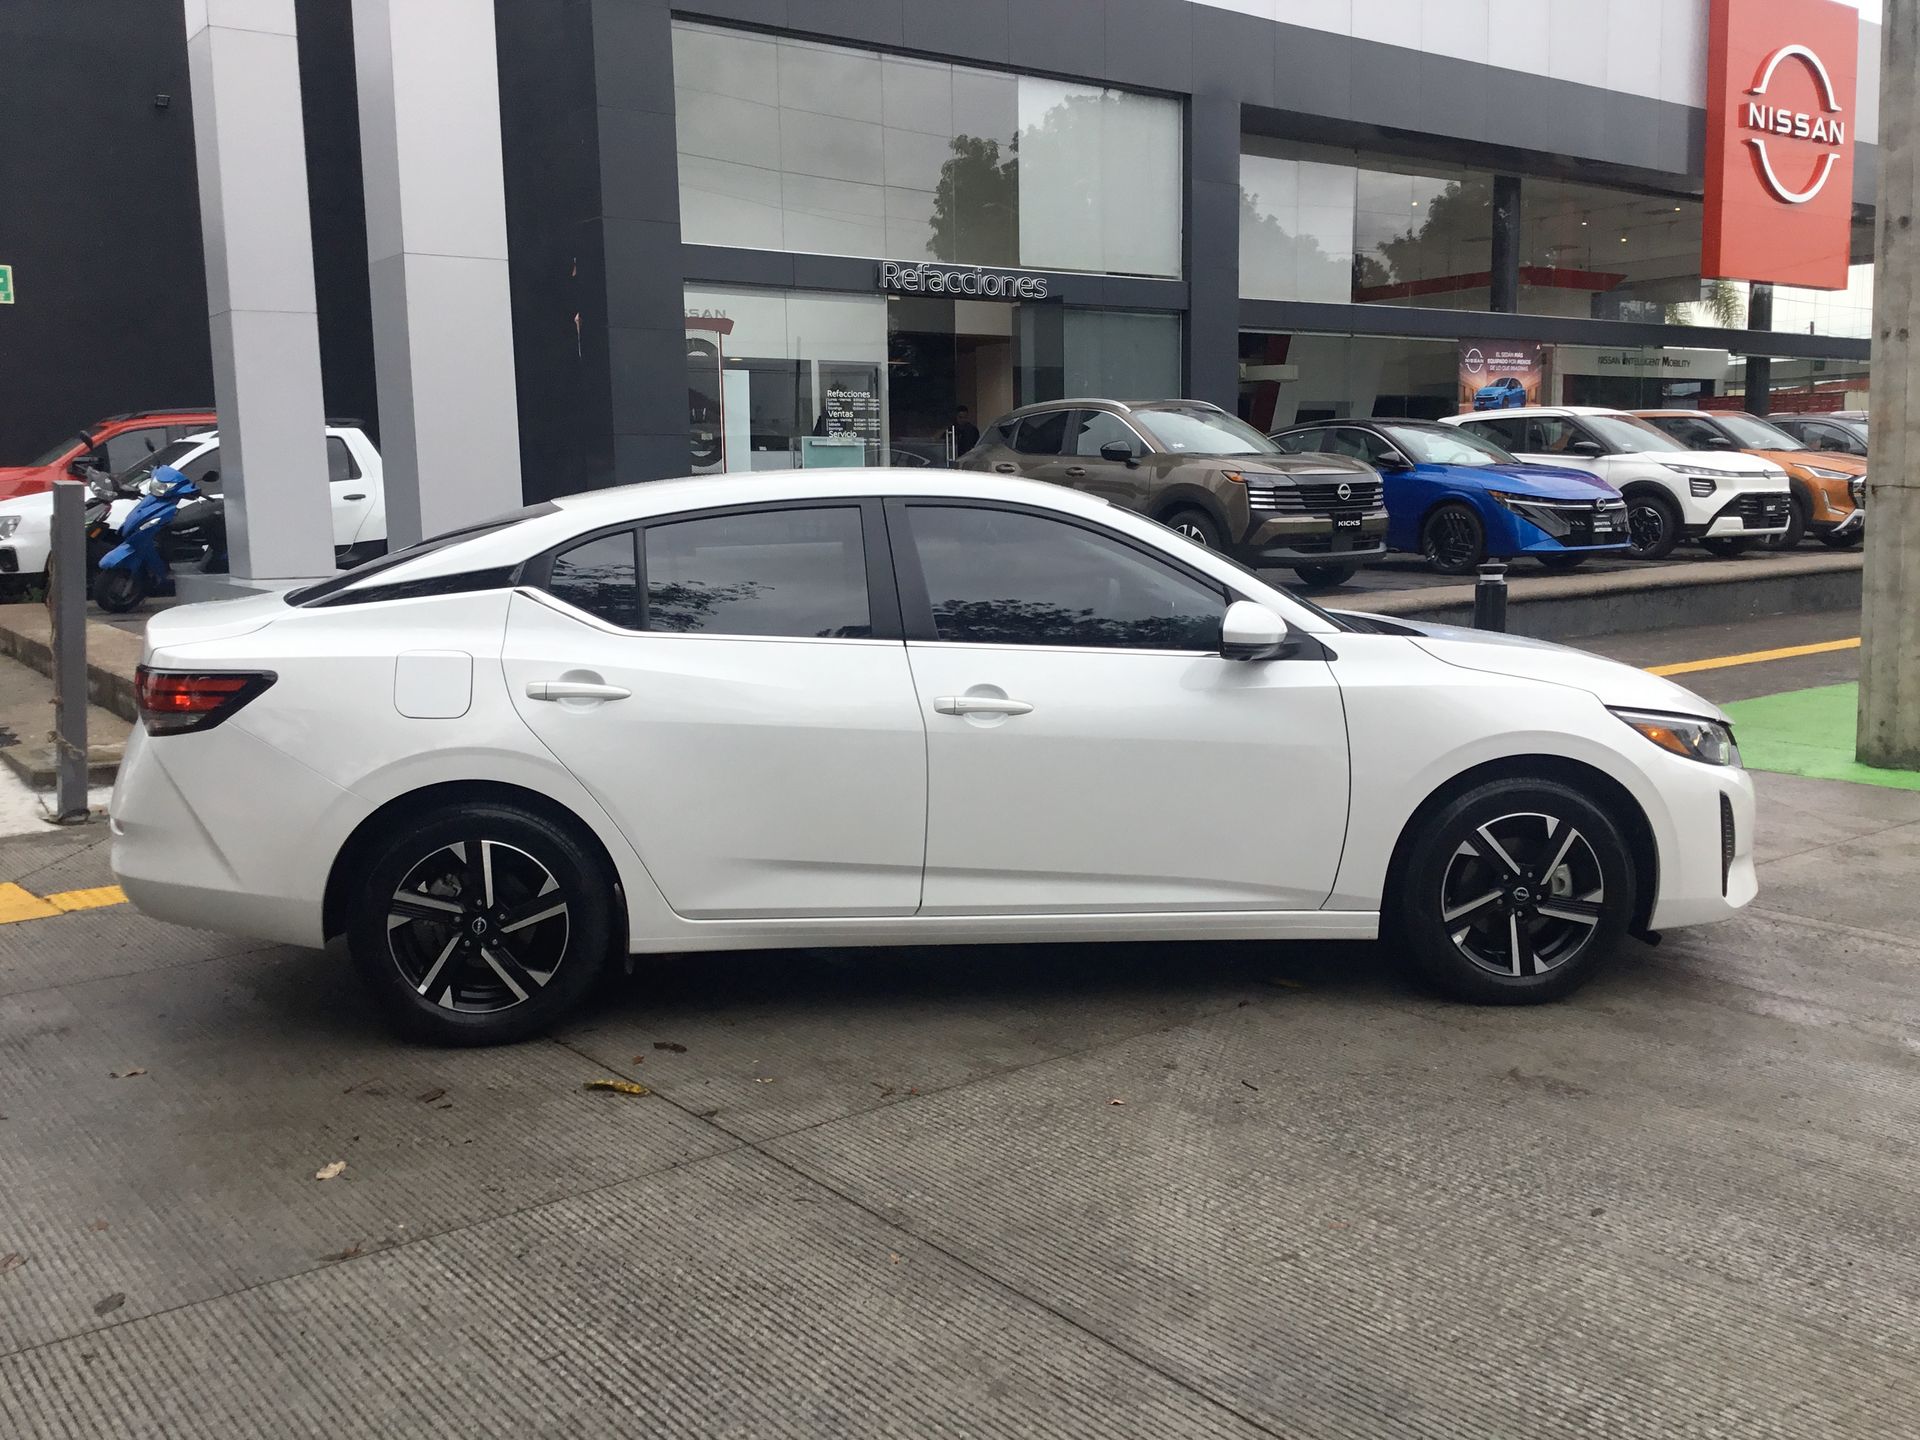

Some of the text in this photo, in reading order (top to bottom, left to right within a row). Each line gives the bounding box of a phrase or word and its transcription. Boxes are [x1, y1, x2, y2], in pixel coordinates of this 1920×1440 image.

[1748, 102, 1844, 144] NISSAN
[881, 261, 1048, 299] Refacciones
[827, 389, 870, 398] Refacciones
[828, 410, 853, 418] Ventas
[829, 430, 857, 438] Servicio
